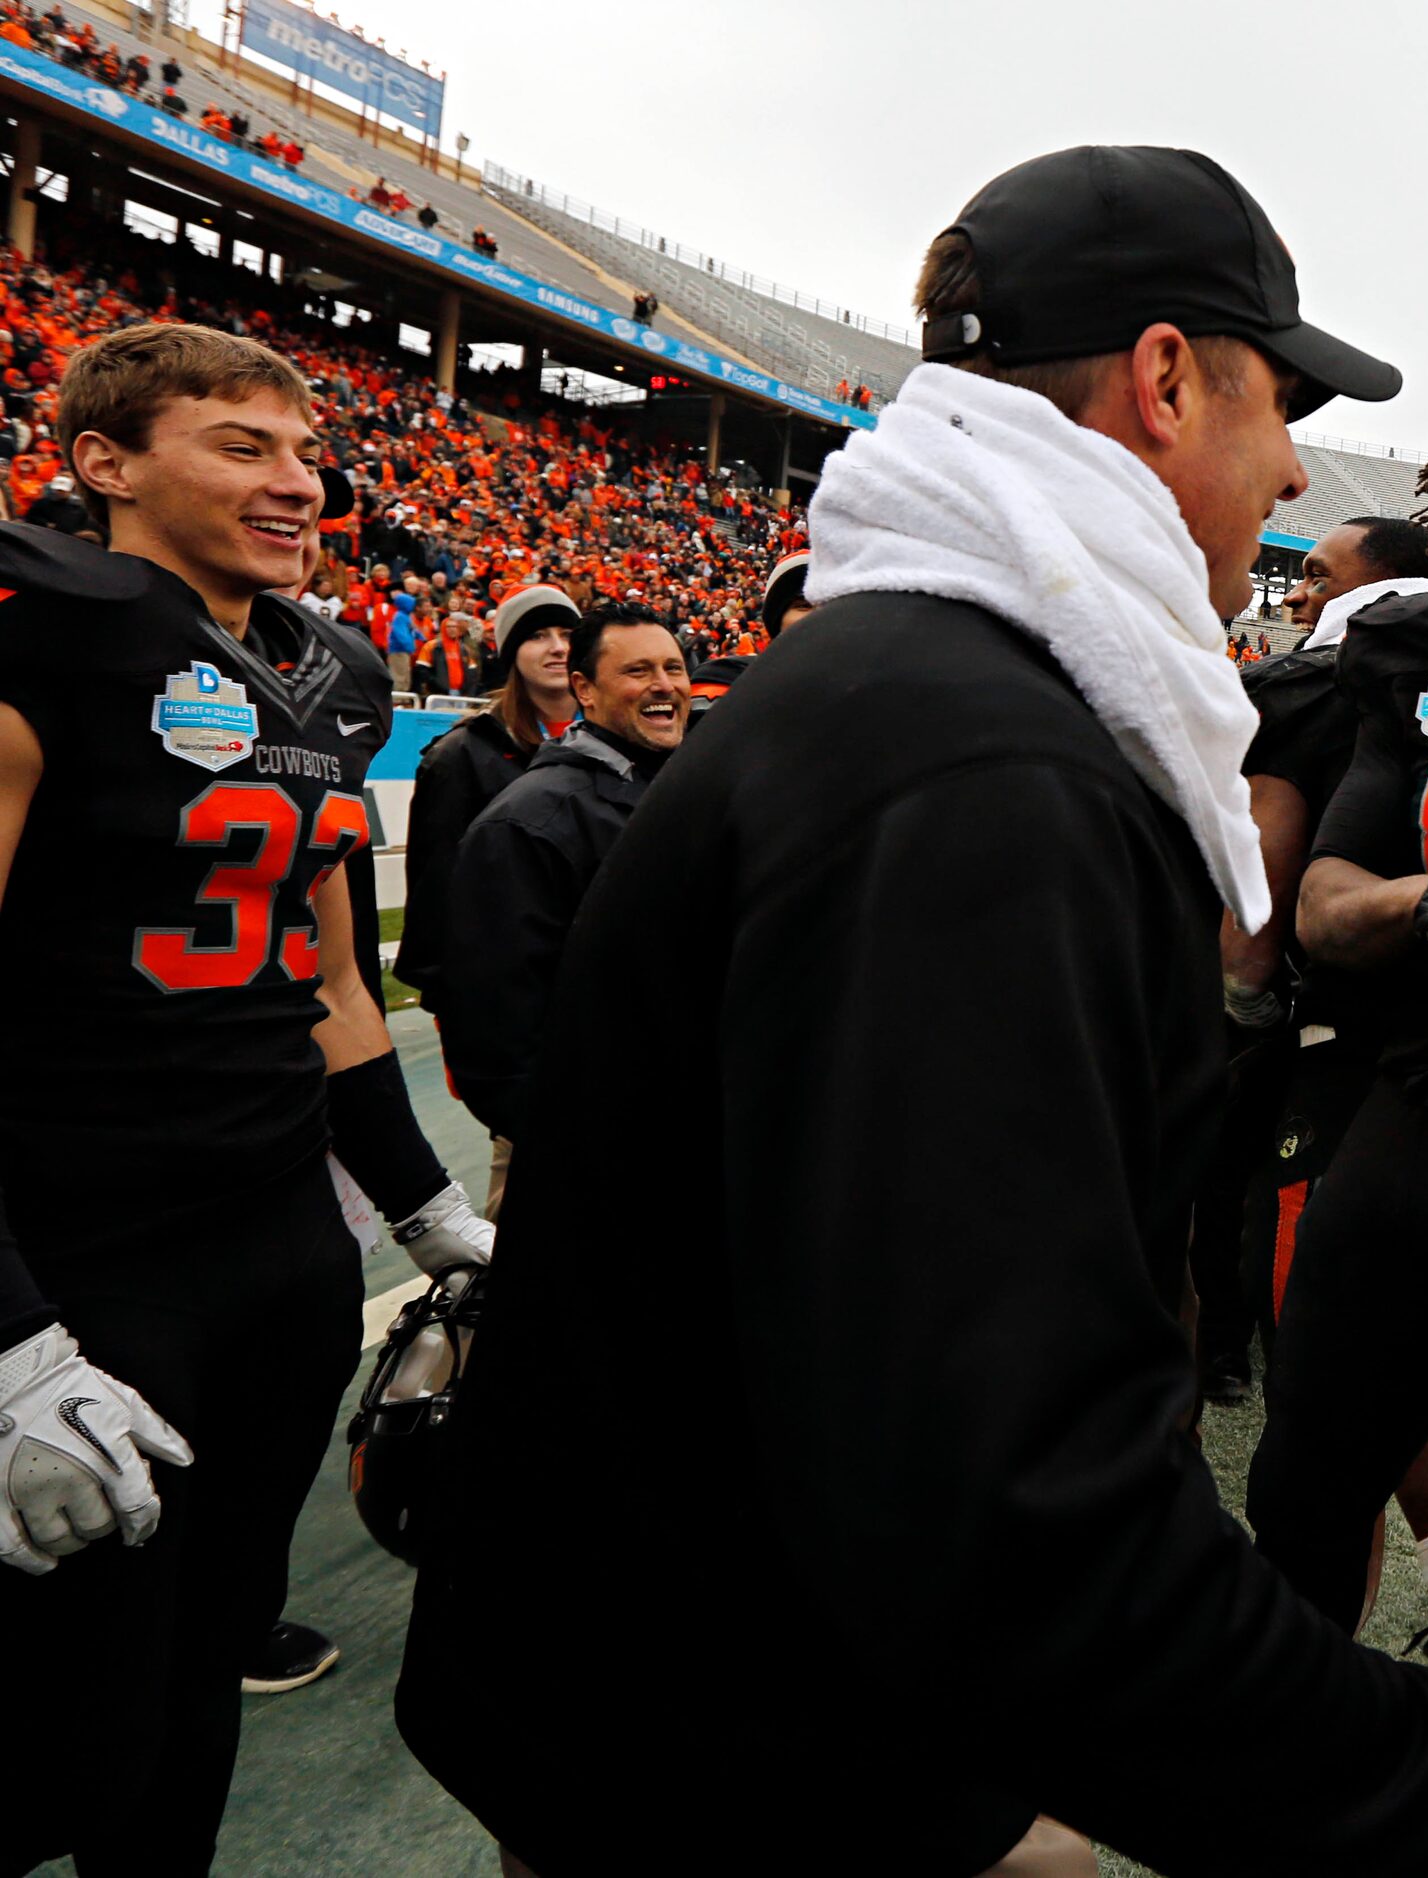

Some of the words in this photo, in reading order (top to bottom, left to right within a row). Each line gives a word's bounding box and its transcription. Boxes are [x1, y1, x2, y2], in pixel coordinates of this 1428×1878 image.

[267, 18, 427, 111] metroPCS
[251, 165, 341, 214] metroPCS
[537, 287, 599, 323] SAMSUNG
[164, 705, 204, 715] HEART
[213, 707, 250, 720] DALLAS
[255, 744, 342, 783] COWBOYS
